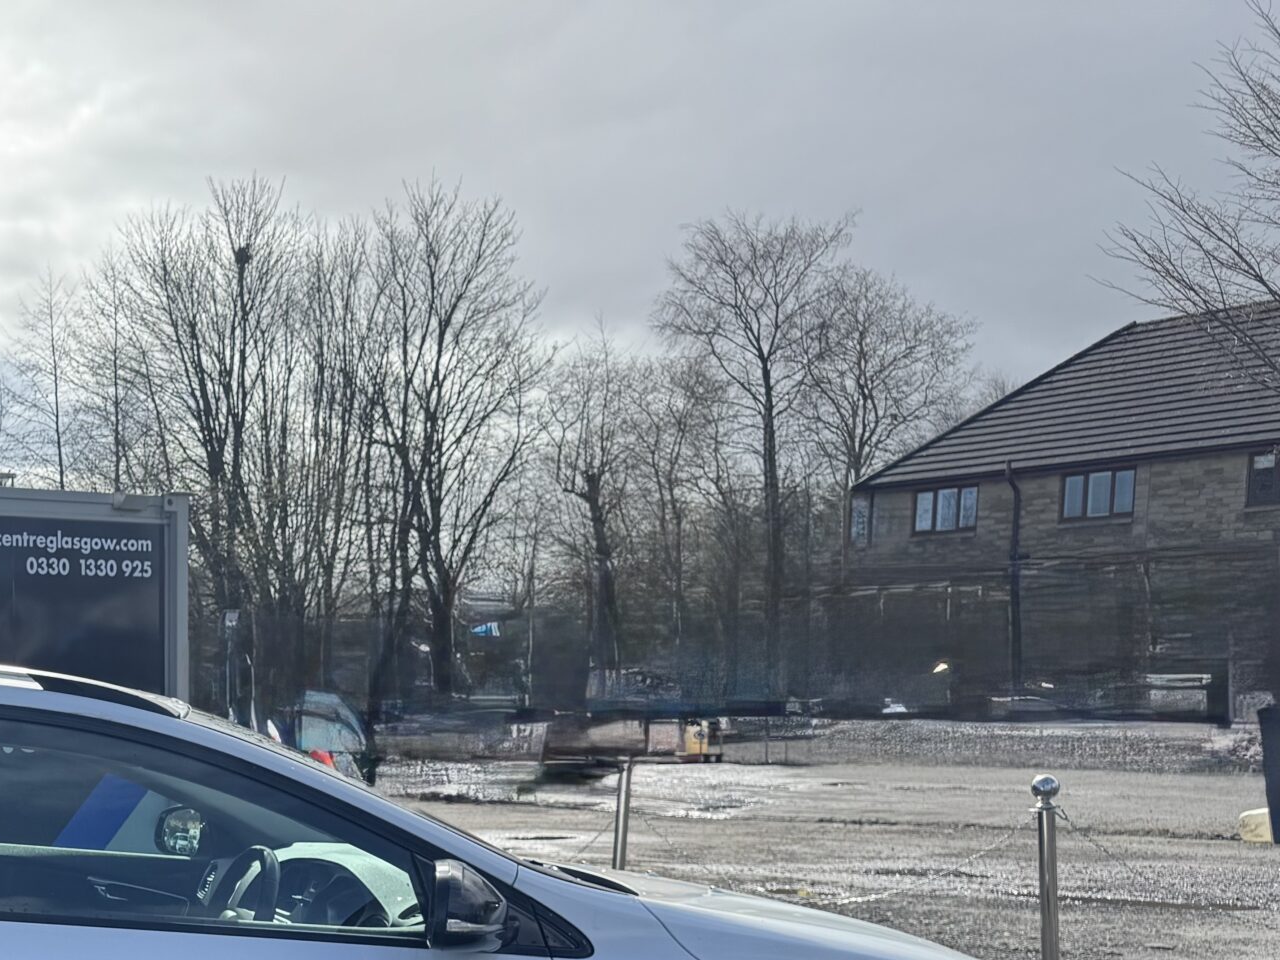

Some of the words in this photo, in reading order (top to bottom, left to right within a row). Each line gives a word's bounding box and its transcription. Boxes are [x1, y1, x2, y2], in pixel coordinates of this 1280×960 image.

[26, 556, 70, 576] 0330
[79, 558, 117, 577] 1330
[121, 560, 152, 578] 925
